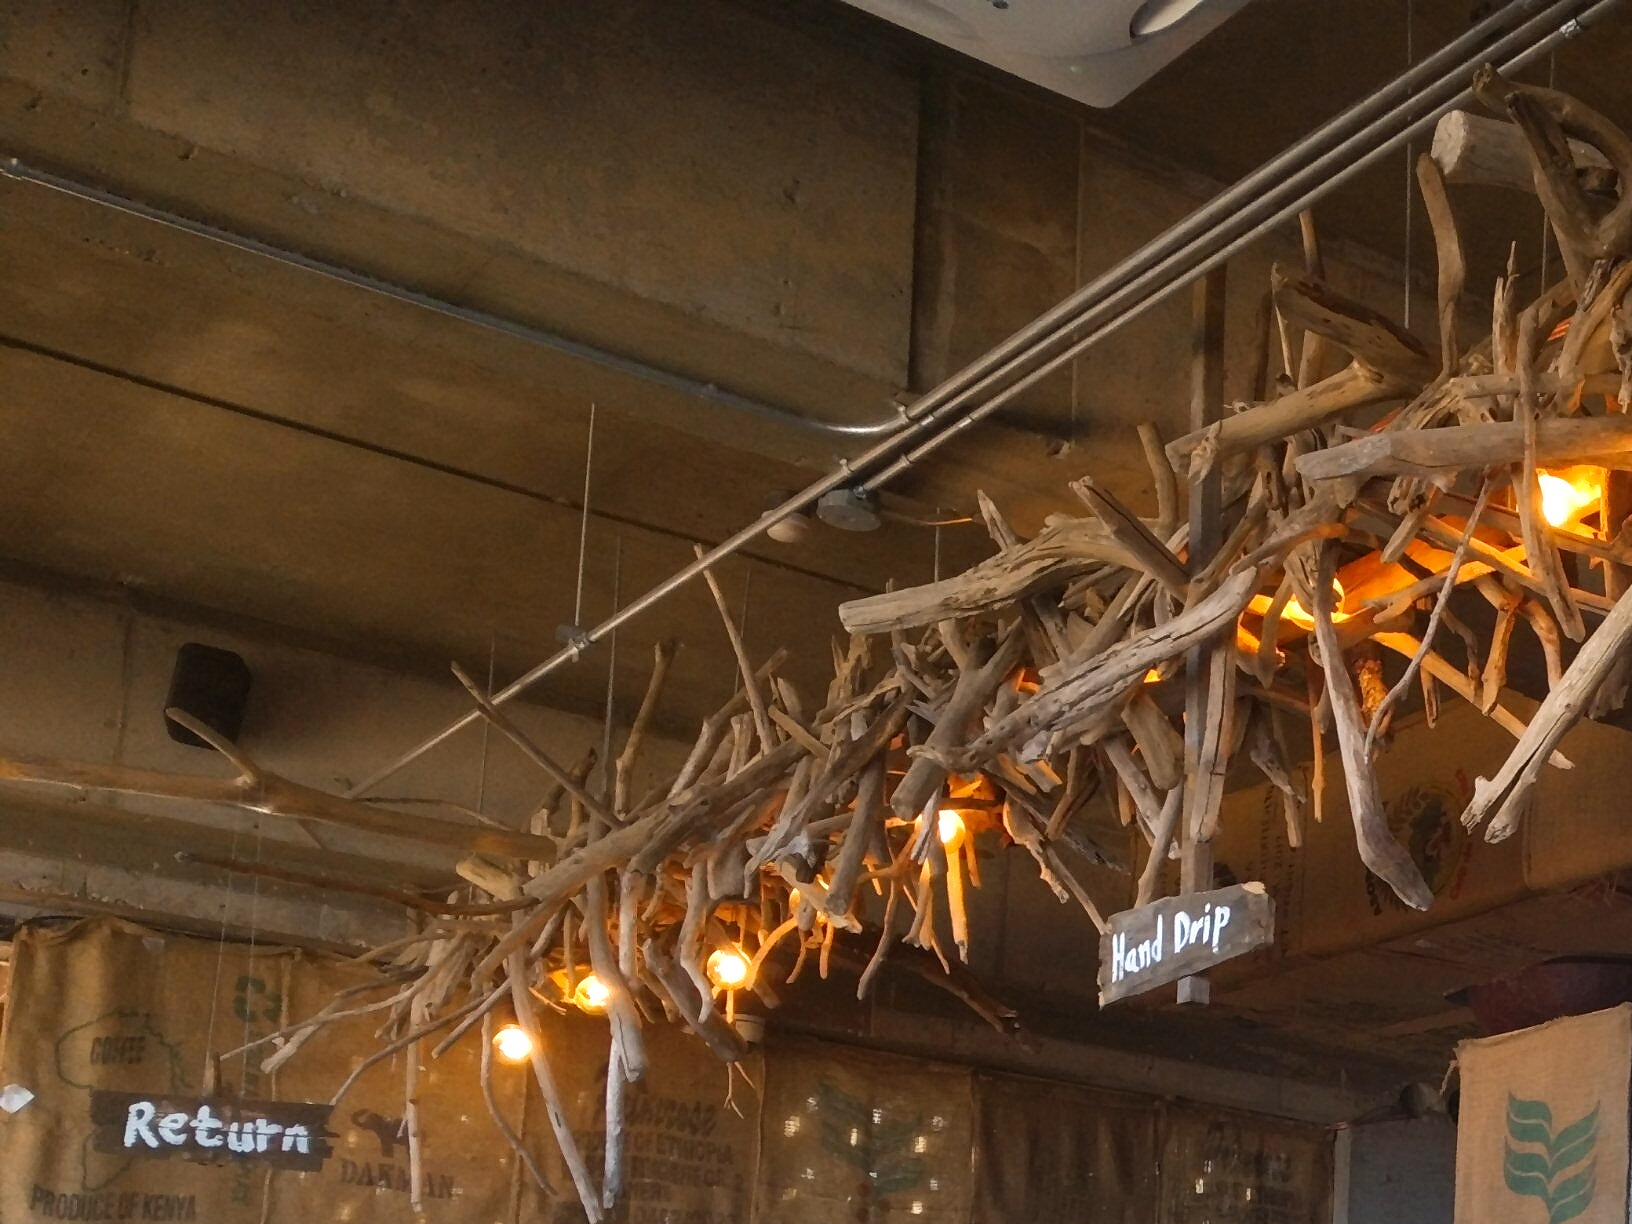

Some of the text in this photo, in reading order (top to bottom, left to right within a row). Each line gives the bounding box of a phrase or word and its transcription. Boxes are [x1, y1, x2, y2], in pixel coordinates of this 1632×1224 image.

[1111, 903, 1231, 983] Hand Drip
[124, 1101, 310, 1154] Return
